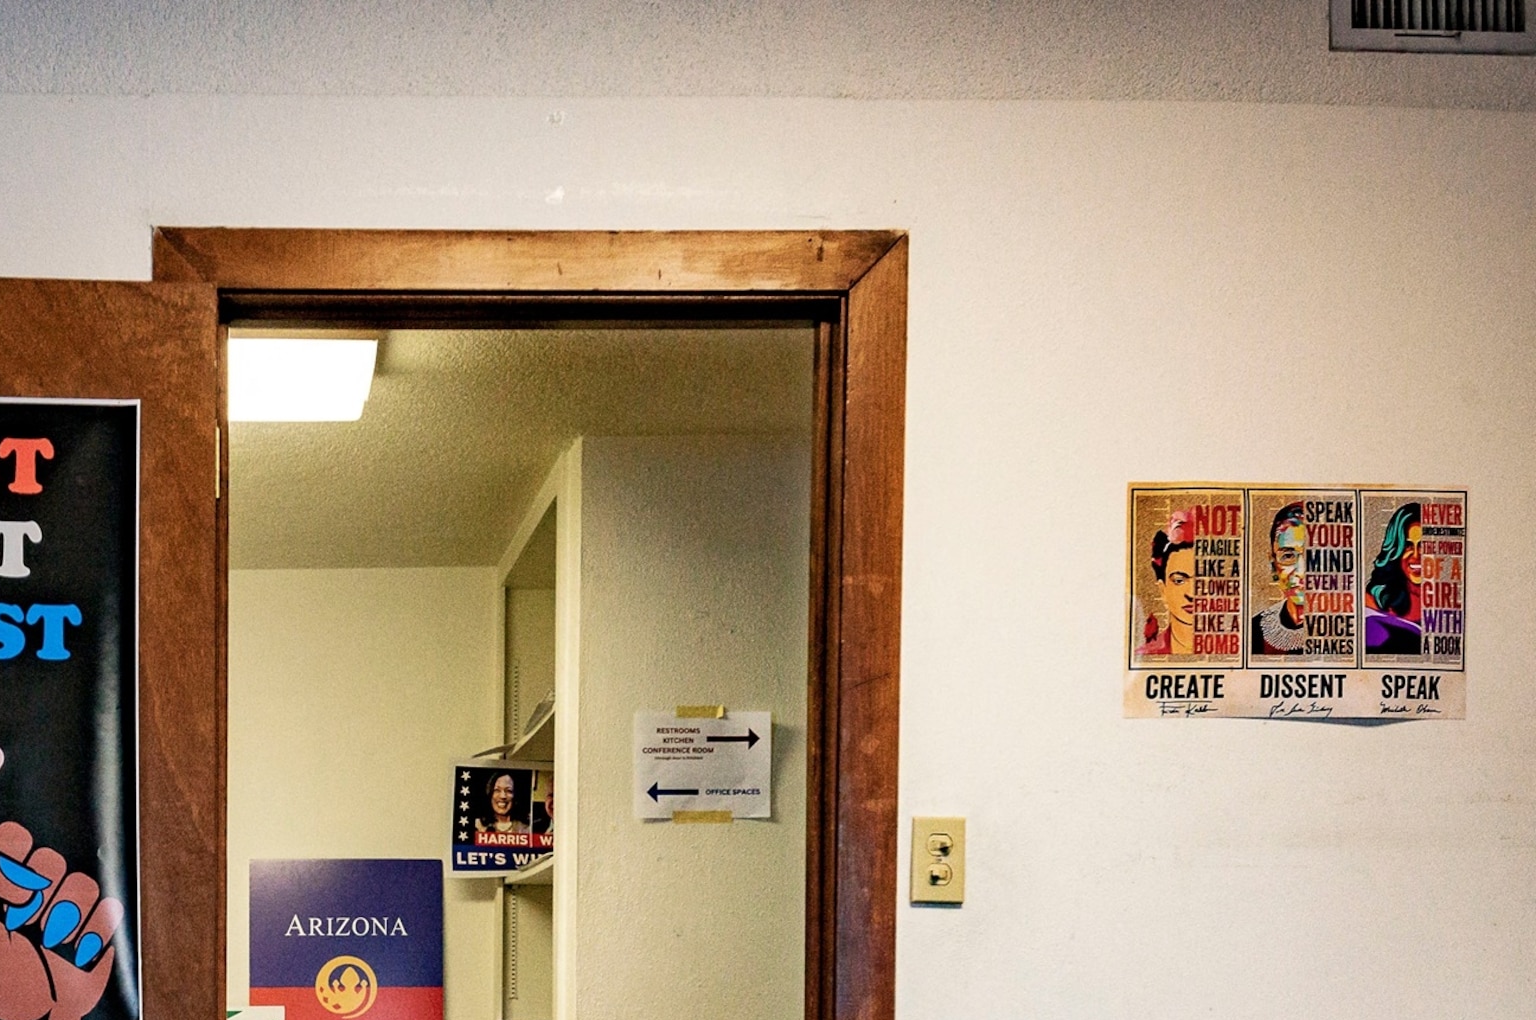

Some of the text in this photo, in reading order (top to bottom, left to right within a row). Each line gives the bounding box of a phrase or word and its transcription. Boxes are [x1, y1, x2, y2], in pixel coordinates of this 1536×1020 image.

[1194, 505, 1241, 537] NOT
[1305, 501, 1354, 523] SPEAK
[1421, 503, 1462, 526] NEVER
[1305, 524, 1354, 548] YOUR
[1195, 539, 1240, 556] FRAGILE
[1422, 541, 1463, 556] THE POWER
[1195, 559, 1240, 577] LIKE A
[1306, 549, 1354, 572] MIND
[1423, 556, 1462, 580] OF A
[1194, 579, 1240, 596] FLOWER
[1305, 574, 1354, 591] EVEN IF
[1194, 598, 1240, 613] FRAGILE
[1305, 592, 1354, 613] YOUR
[1422, 581, 1462, 609] GIRL
[1194, 614, 1239, 632] LIKE A
[1305, 615, 1355, 637] VOICE
[1423, 609, 1462, 634] WITH
[1193, 634, 1239, 655] BOMB
[1305, 638, 1354, 655] SHAKES
[1423, 636, 1462, 655] A BOOK
[1145, 674, 1225, 699] CREATE
[1260, 674, 1347, 699] DISSENT
[1381, 674, 1441, 700] SPEAK
[705, 788, 731, 796] OFFICE
[477, 833, 528, 845] HARRIS
[456, 852, 507, 865] LET'S
